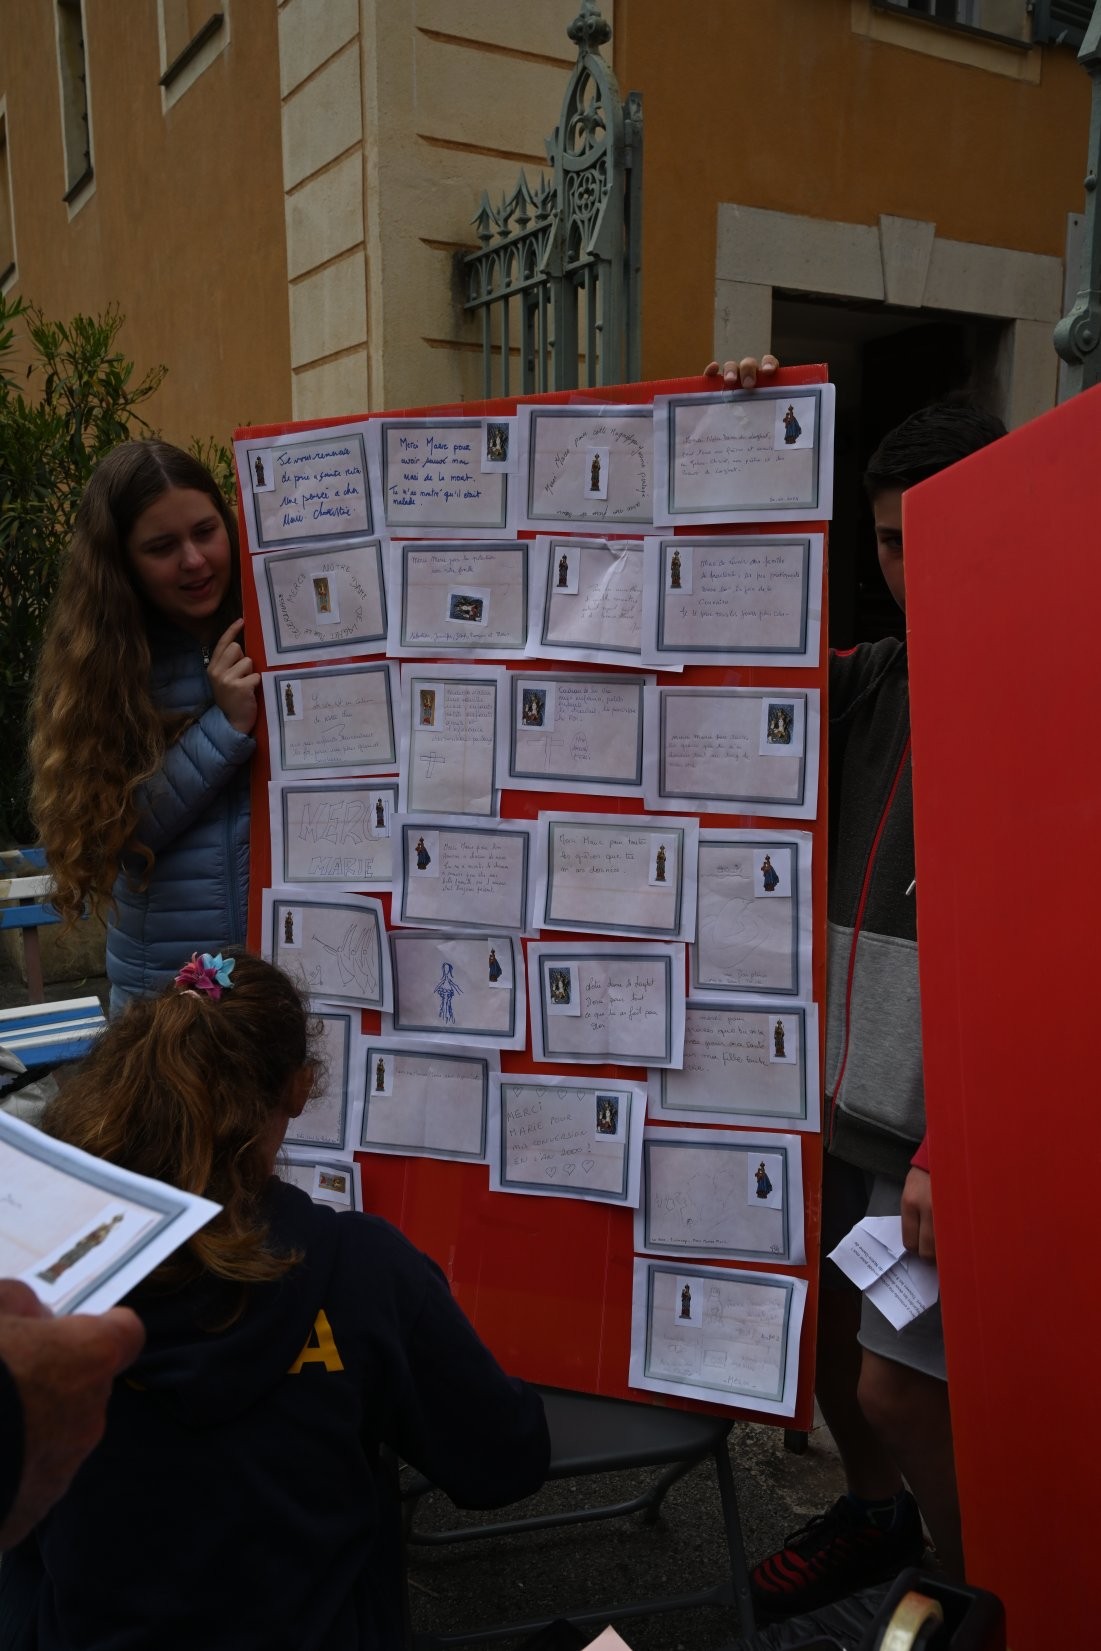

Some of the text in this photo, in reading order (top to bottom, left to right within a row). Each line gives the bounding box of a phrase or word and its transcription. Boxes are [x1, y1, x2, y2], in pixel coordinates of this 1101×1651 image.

[400, 436, 472, 455] Merci Marie pour
[277, 452, 292, 466] Je
[294, 455, 311, 464] vous
[438, 472, 444, 481] la
[389, 485, 398, 495] Tu
[444, 490, 461, 502] qu'il
[322, 564, 351, 572] NOTRE
[355, 606, 363, 623] DE
[583, 836, 604, 845] Marie
[309, 857, 374, 878] MARIE
[632, 993, 643, 1001] tout
[510, 1114, 573, 1136] MARIE POUR
[533, 1131, 587, 1146] CONVERSION
[288, 1309, 344, 1373] A
